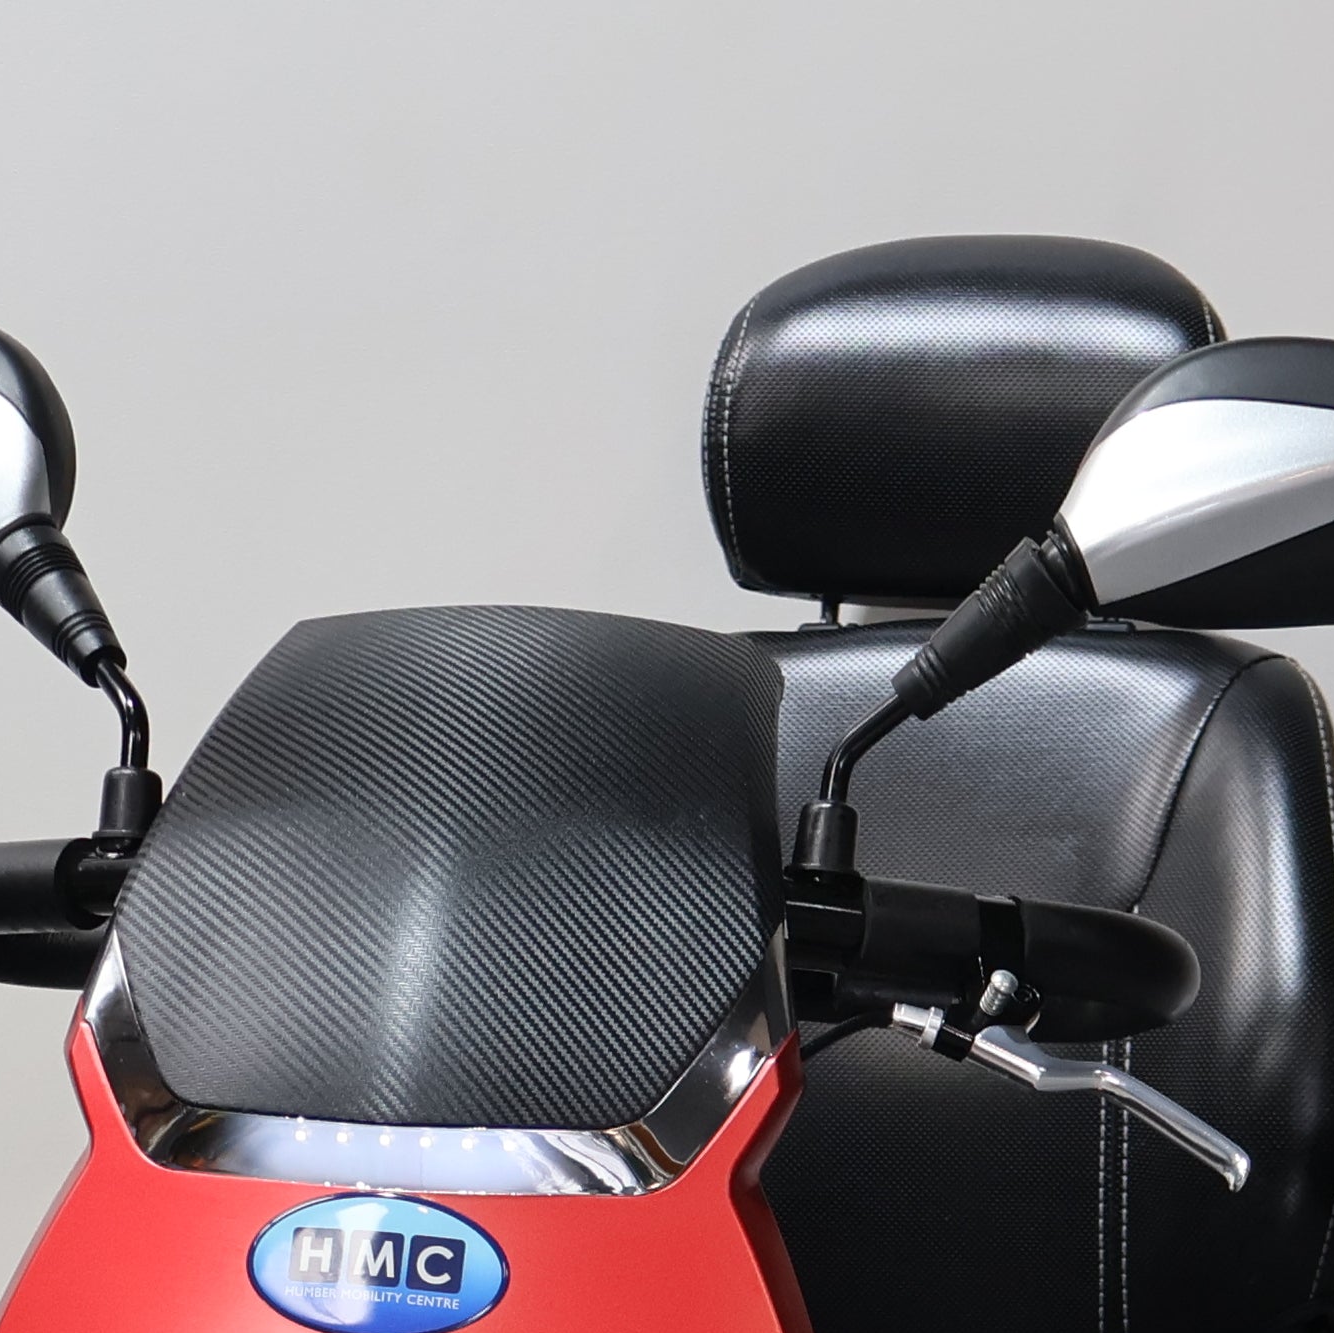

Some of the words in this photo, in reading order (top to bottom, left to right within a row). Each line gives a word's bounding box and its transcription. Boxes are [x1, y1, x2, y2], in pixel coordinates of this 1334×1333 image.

[298, 1235, 455, 1286] HMC
[284, 1285, 337, 1300] HUMBER
[340, 1288, 403, 1305] MOBILITY
[406, 1293, 460, 1310] CENTRE
